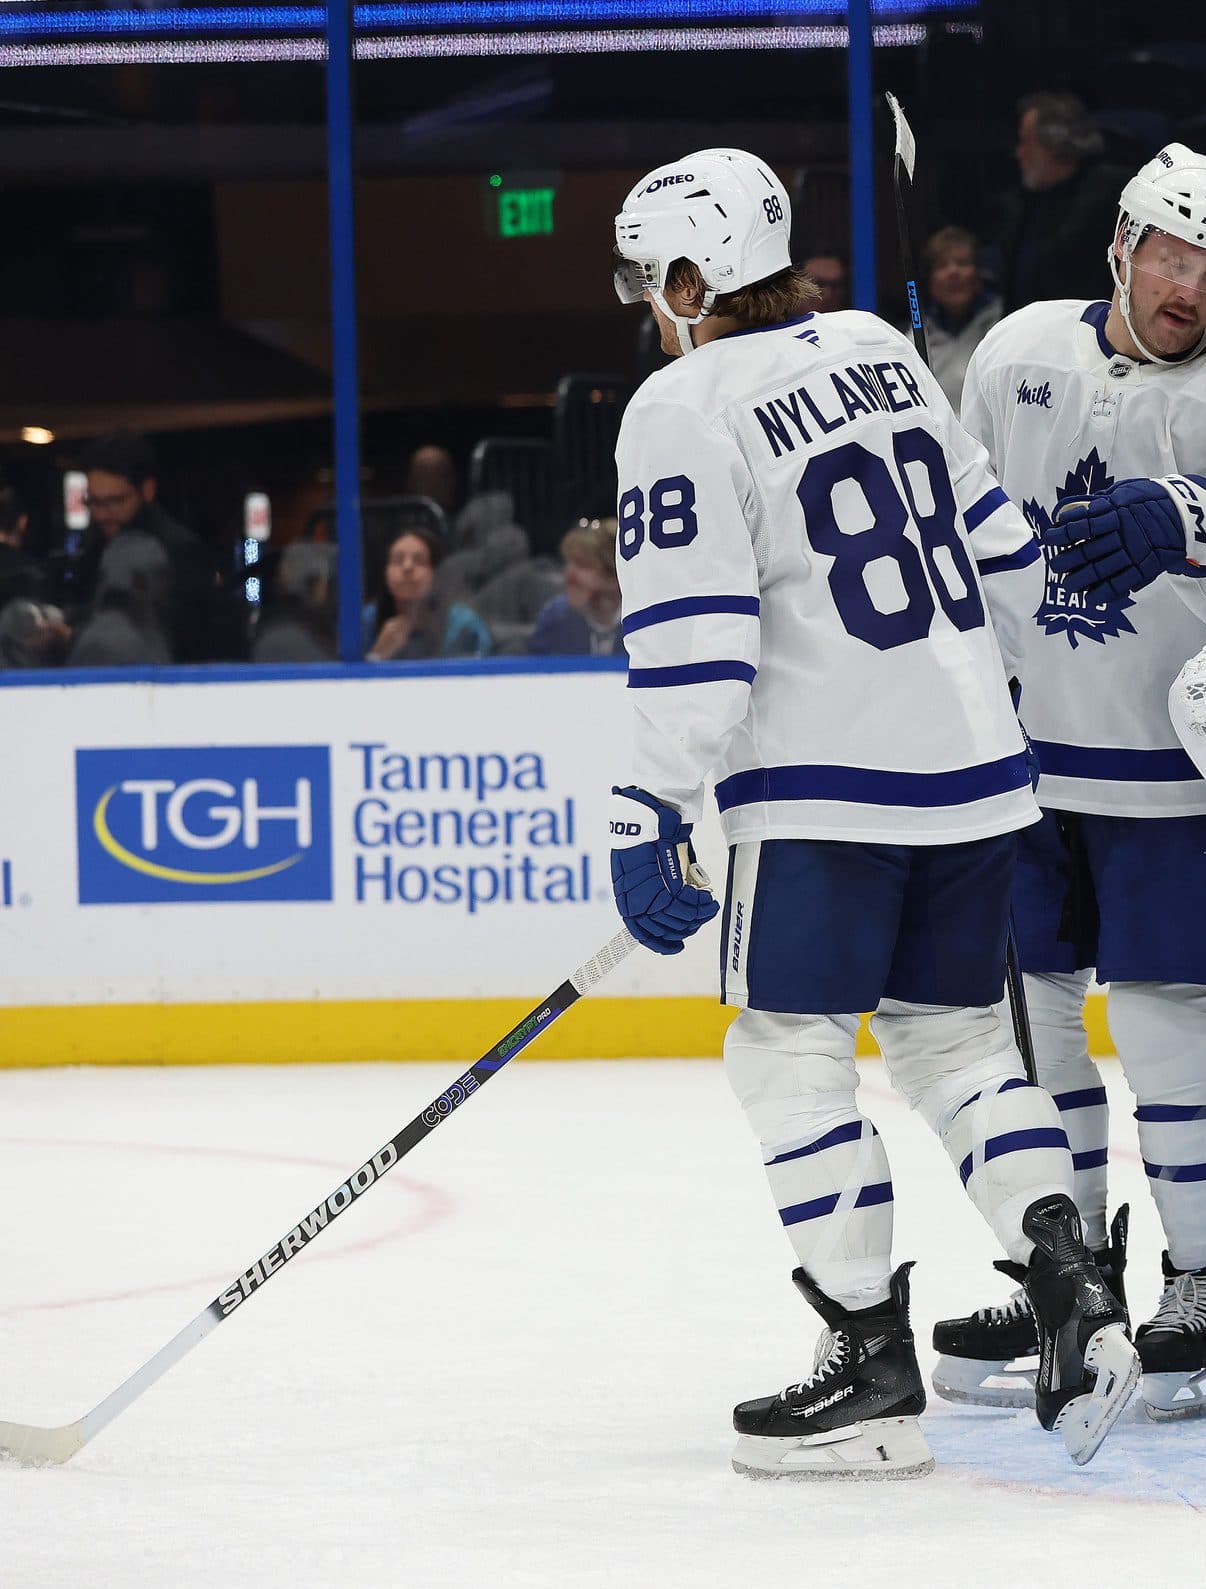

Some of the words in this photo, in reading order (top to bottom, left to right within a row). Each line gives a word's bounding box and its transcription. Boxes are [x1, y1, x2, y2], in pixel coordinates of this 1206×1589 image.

[646, 174, 694, 193] OREO
[1158, 151, 1174, 169] REO
[499, 188, 555, 237] EXIT
[763, 195, 783, 224] 88
[753, 362, 927, 458] NYLANDER
[1017, 379, 1053, 409] Milk
[619, 474, 698, 562] 88
[797, 427, 986, 651] 88
[349, 743, 547, 798] Tampa
[121, 778, 312, 851] TGH
[353, 797, 575, 849] General
[356, 854, 591, 914] Hospital
[732, 901, 744, 974] BAUER
[536, 1007, 551, 1023] PRO
[421, 1070, 481, 1128] CODE
[218, 1142, 398, 1316] SHERWOOD
[803, 1386, 854, 1418] BAUER
